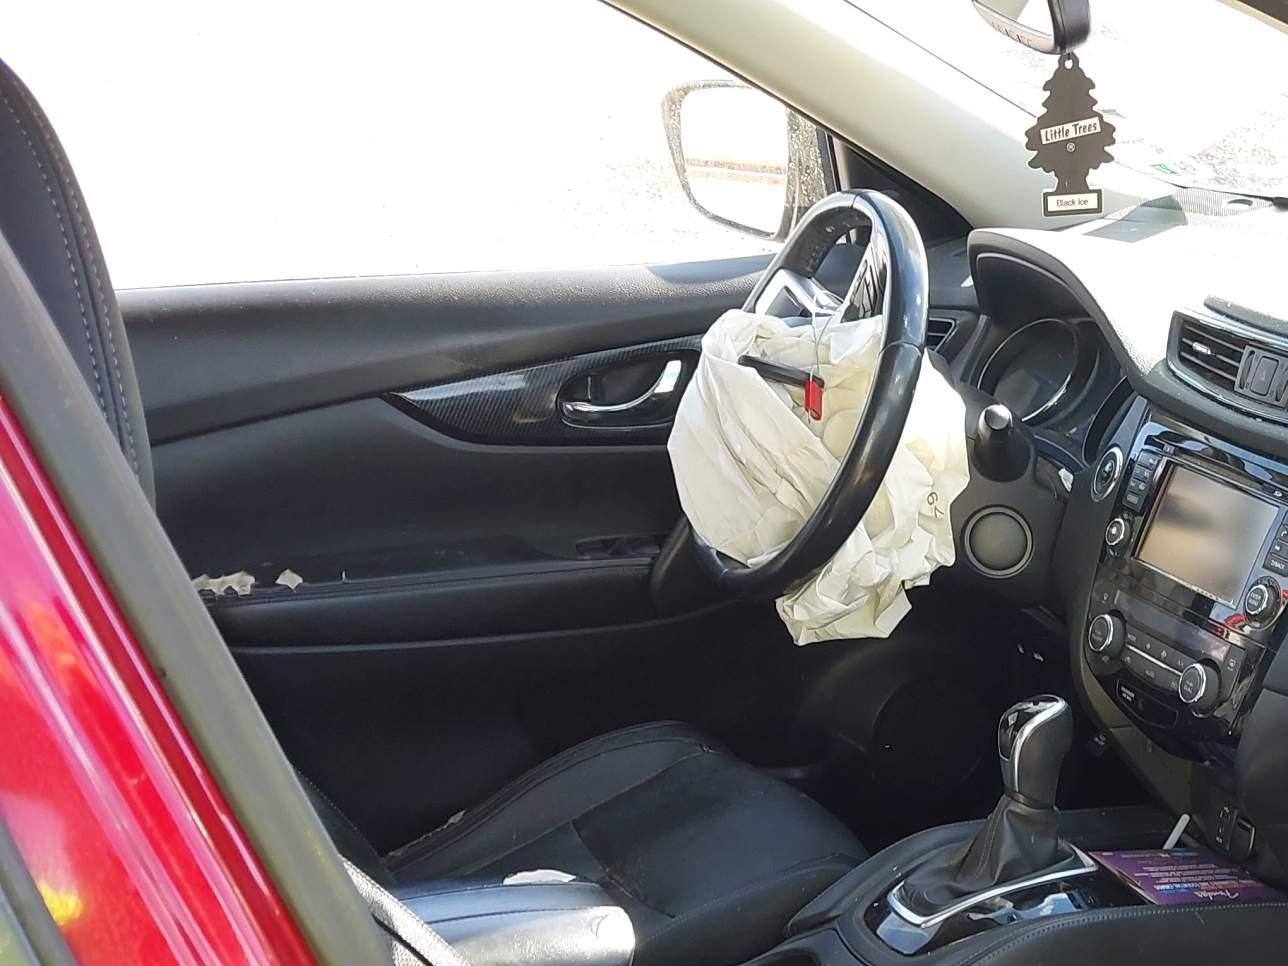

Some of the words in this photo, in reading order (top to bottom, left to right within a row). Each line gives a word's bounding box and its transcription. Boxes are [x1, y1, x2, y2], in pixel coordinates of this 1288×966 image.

[1044, 126, 1070, 142] Little
[1071, 122, 1098, 136] Trees
[1056, 199, 1076, 208] Black
